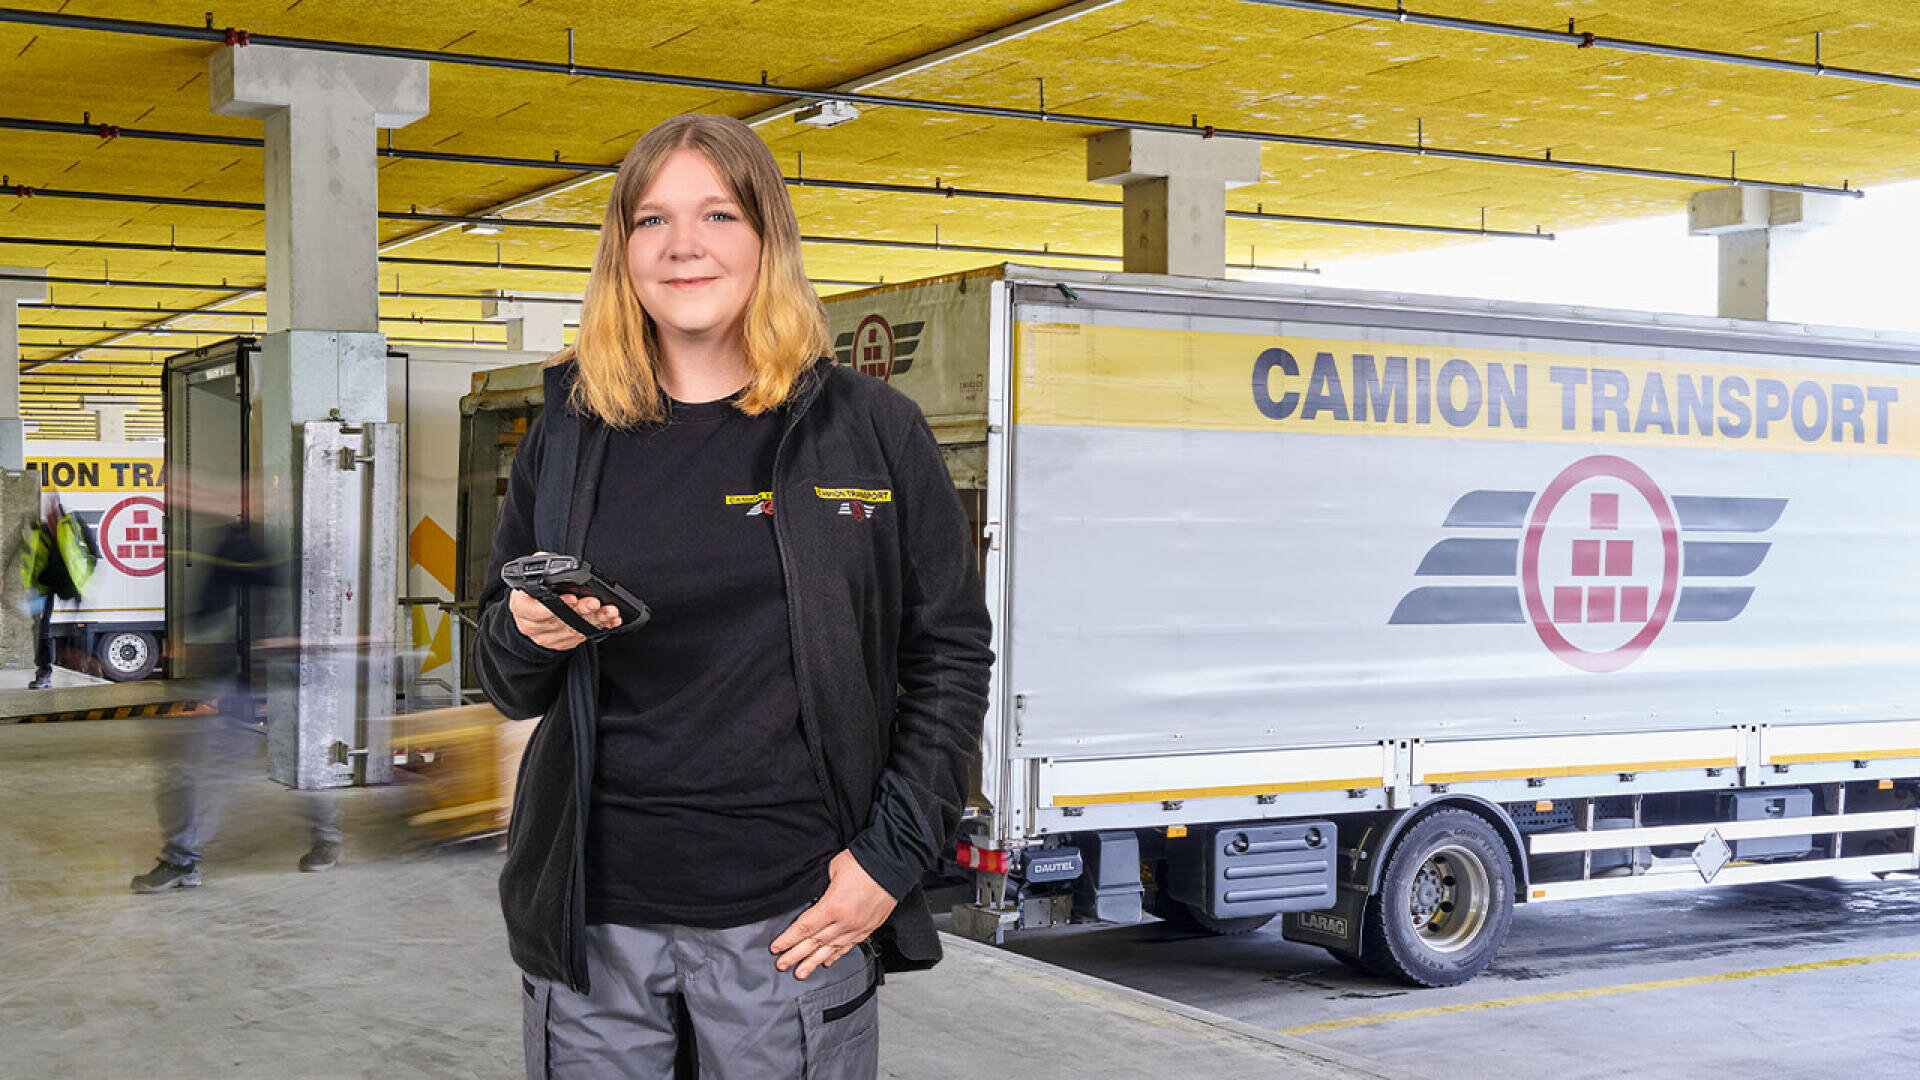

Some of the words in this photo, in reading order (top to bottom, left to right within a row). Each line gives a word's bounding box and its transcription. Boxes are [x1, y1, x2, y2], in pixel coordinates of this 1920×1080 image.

[1252, 347, 1527, 429] CAMION
[1550, 365, 1898, 444] TRANSPORT
[26, 462, 99, 487] ION
[1034, 861, 1075, 874] DAUTEL
[1301, 912, 1345, 935] LARAG
